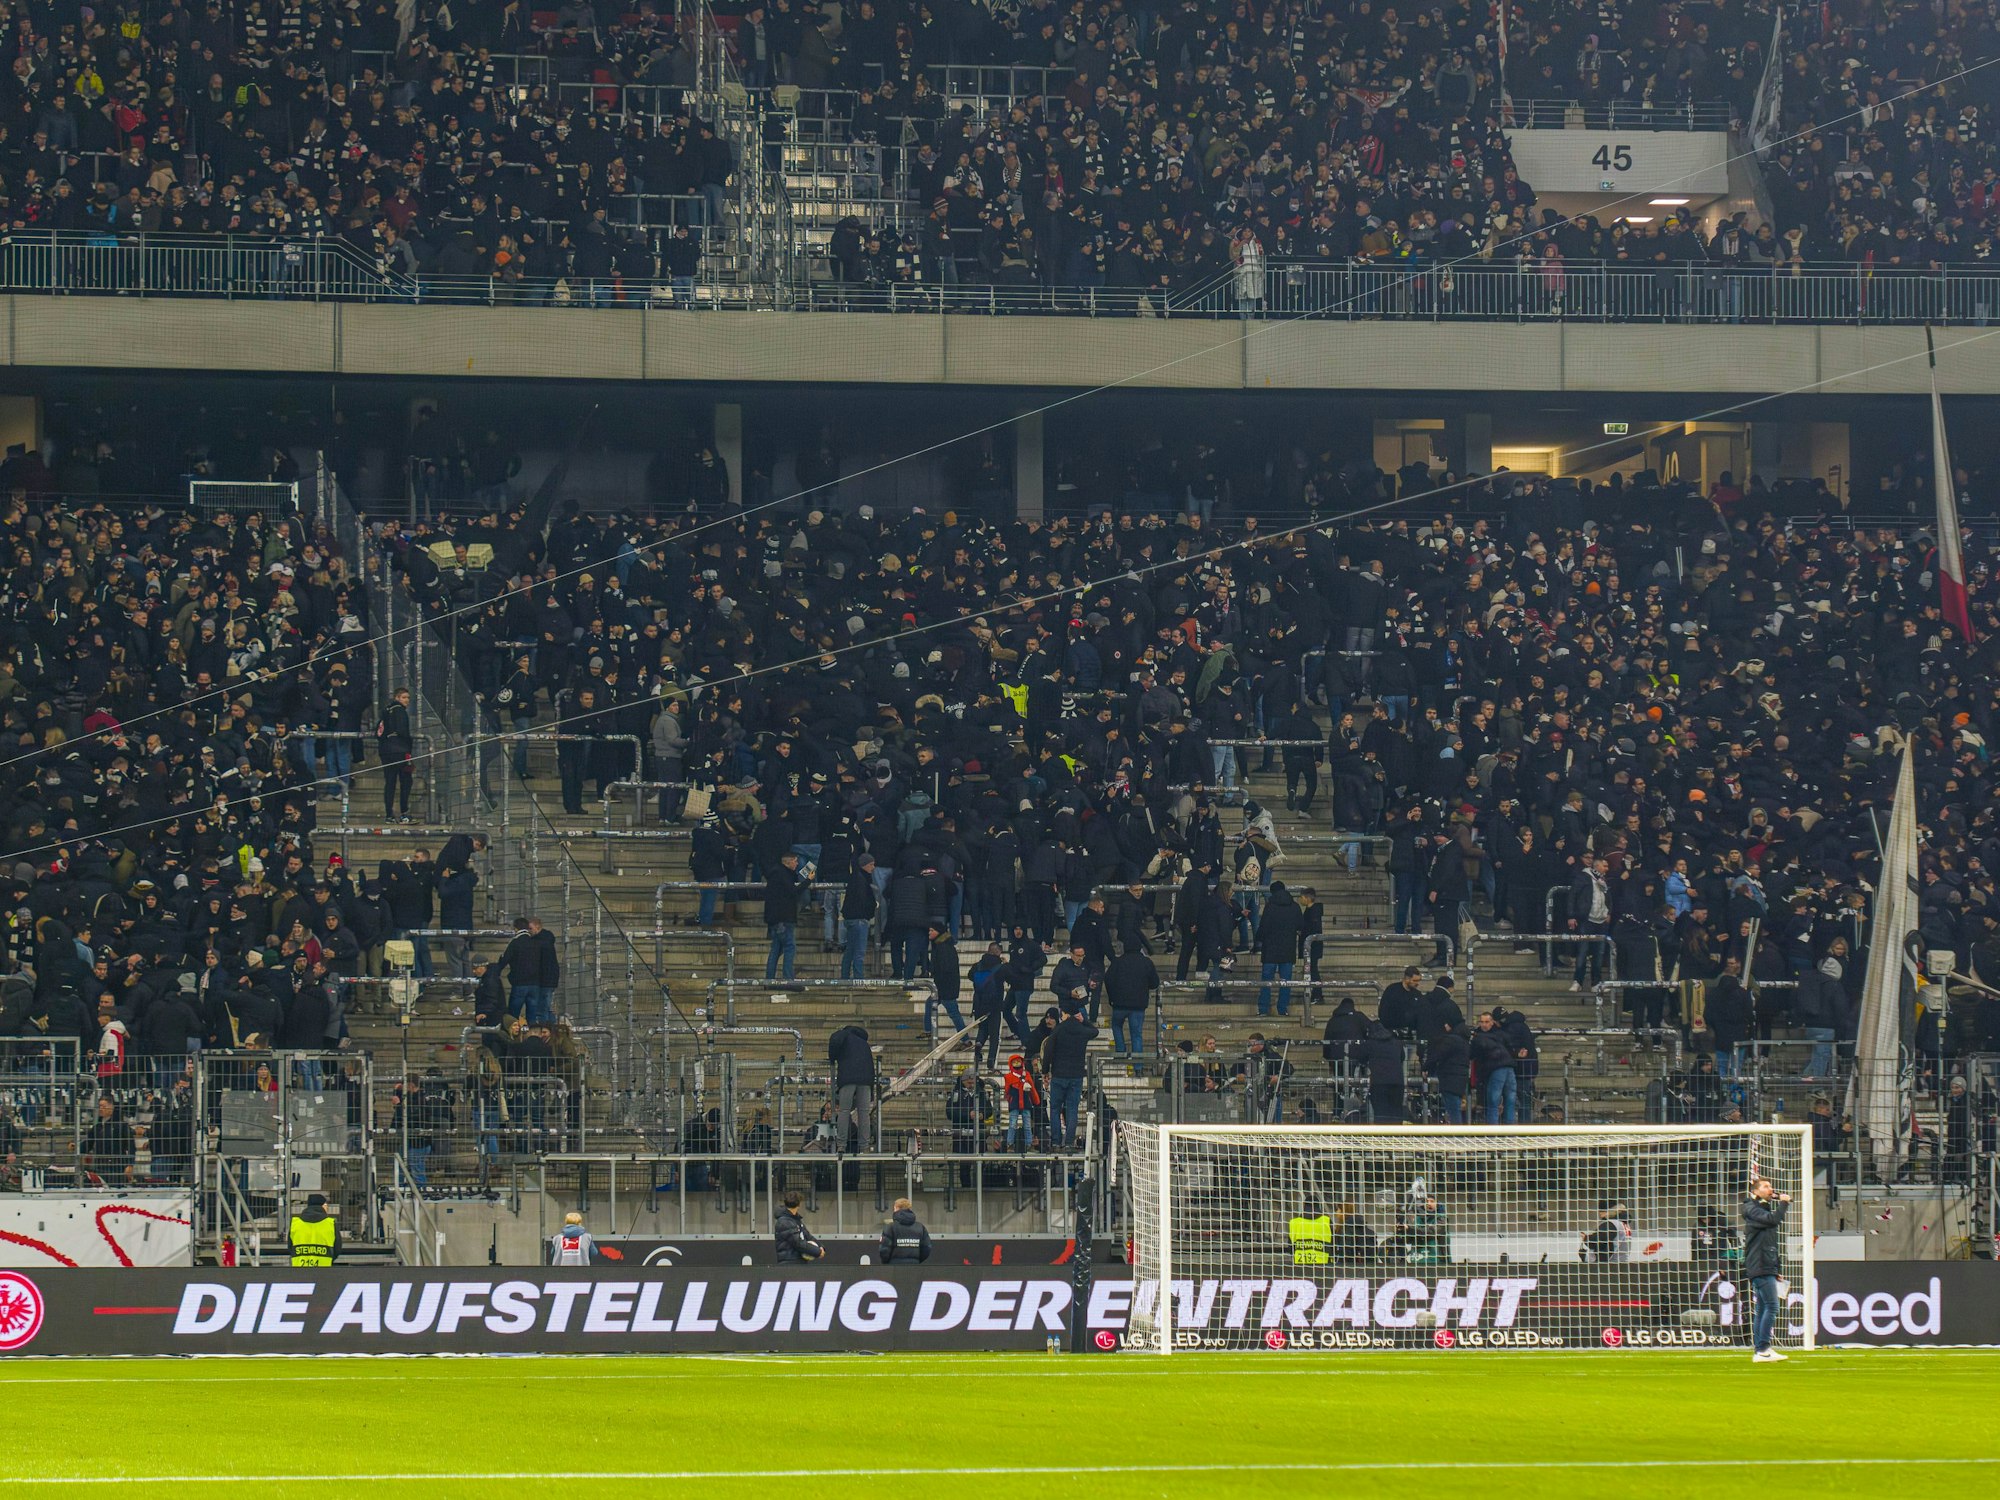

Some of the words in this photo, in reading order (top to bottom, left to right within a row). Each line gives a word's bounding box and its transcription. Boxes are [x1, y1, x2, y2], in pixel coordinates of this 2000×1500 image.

[1591, 144, 1633, 172] 45
[295, 1246, 327, 1255] STEWARD
[1295, 1240, 1323, 1250] TEWARD
[173, 1282, 315, 1334] DIE
[319, 1280, 898, 1335] AUFSTELLUNG
[910, 1279, 1072, 1332] DER
[1086, 1277, 1538, 1329] EINTRACHT
[1119, 1333, 1144, 1347] LG
[1203, 1337, 1226, 1347] evo
[1289, 1332, 1314, 1347] LG
[1321, 1332, 1370, 1347] OLED
[1373, 1337, 1395, 1347] evo
[1459, 1331, 1483, 1346] LG
[1490, 1331, 1539, 1345] OLED
[1541, 1337, 1563, 1346] evo
[1626, 1329, 1651, 1344] LG
[1656, 1329, 1706, 1344] OLED
